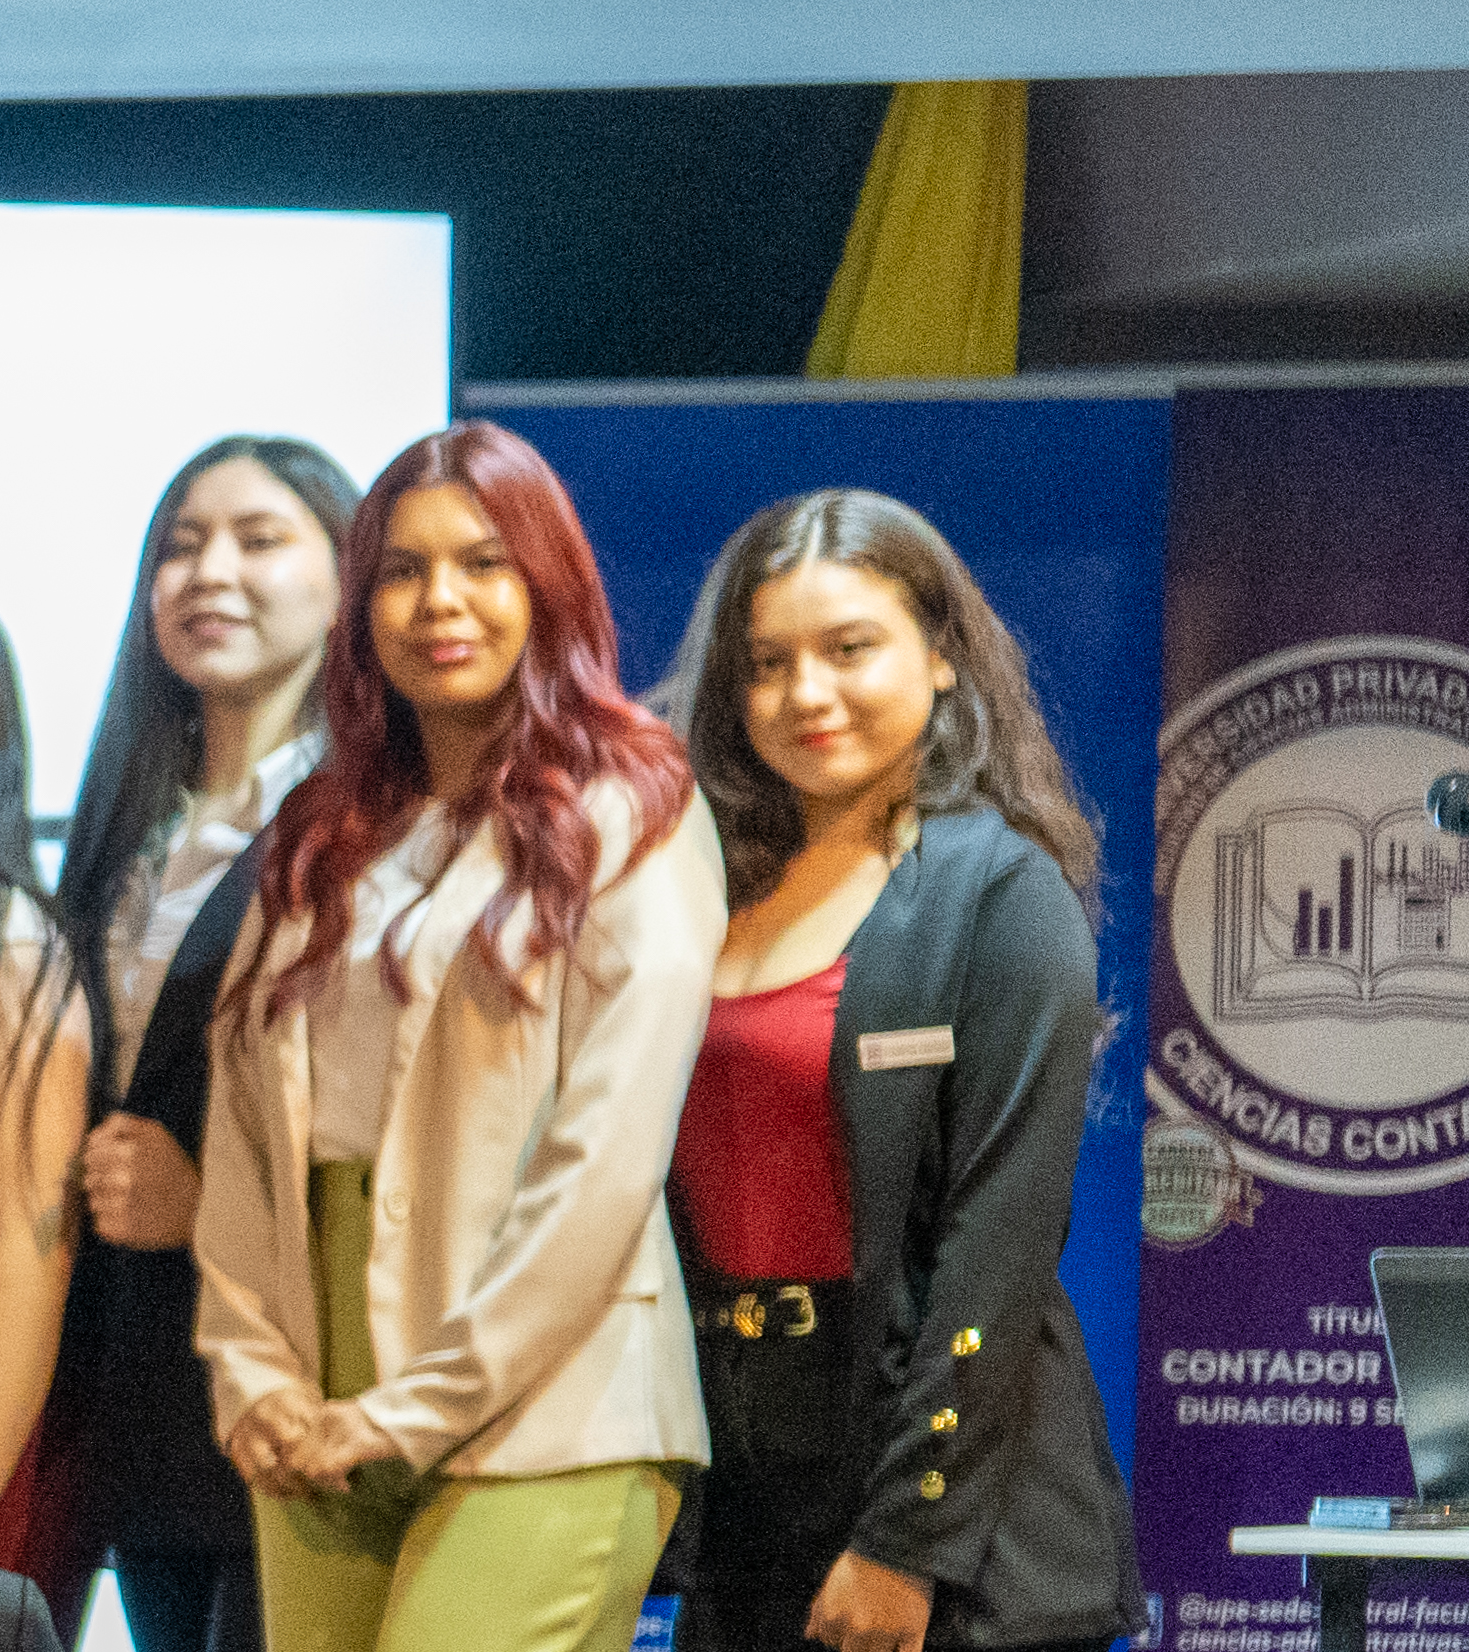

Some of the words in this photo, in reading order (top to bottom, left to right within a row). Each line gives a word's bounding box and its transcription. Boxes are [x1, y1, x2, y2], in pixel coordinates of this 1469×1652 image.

[1331, 662, 1469, 702] PRIVAD
[1161, 1028, 1331, 1157] CIENCIAS
[1308, 1302, 1385, 1336] TÍTUL
[1163, 1349, 1382, 1385] CONTADOR
[1177, 1391, 1342, 1427] DURACIÓN:
[1350, 1396, 1367, 1426] 9
